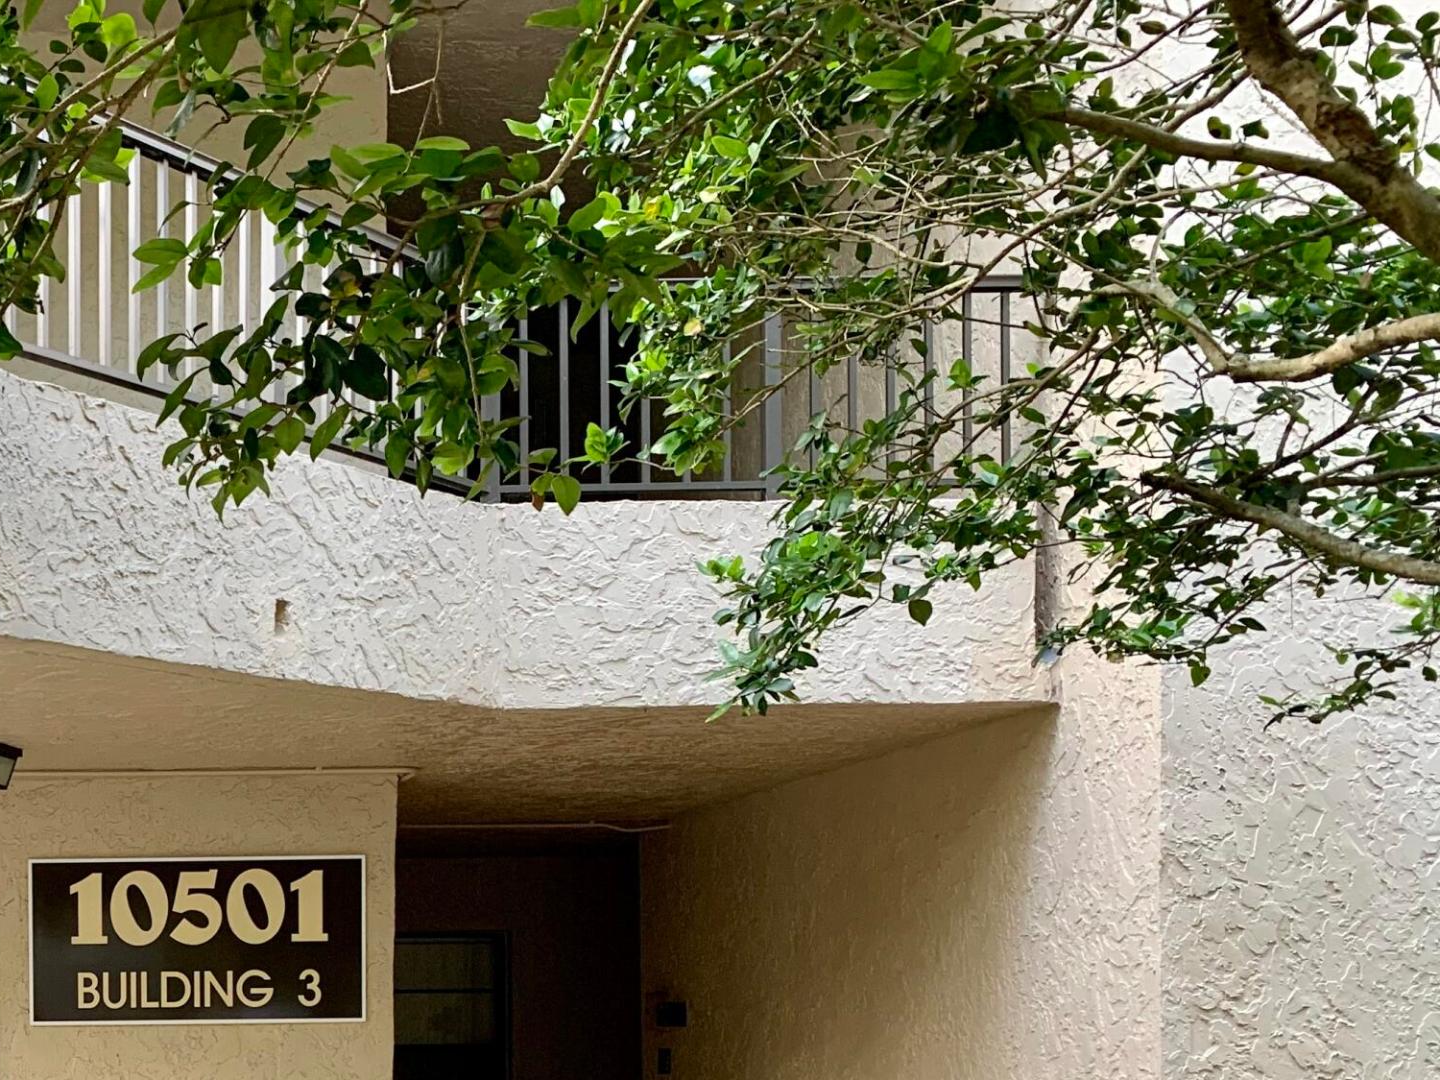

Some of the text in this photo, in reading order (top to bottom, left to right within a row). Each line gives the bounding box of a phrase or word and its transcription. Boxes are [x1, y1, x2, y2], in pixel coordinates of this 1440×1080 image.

[70, 868, 329, 947] 10501
[77, 968, 322, 1010] BUILDING 3
